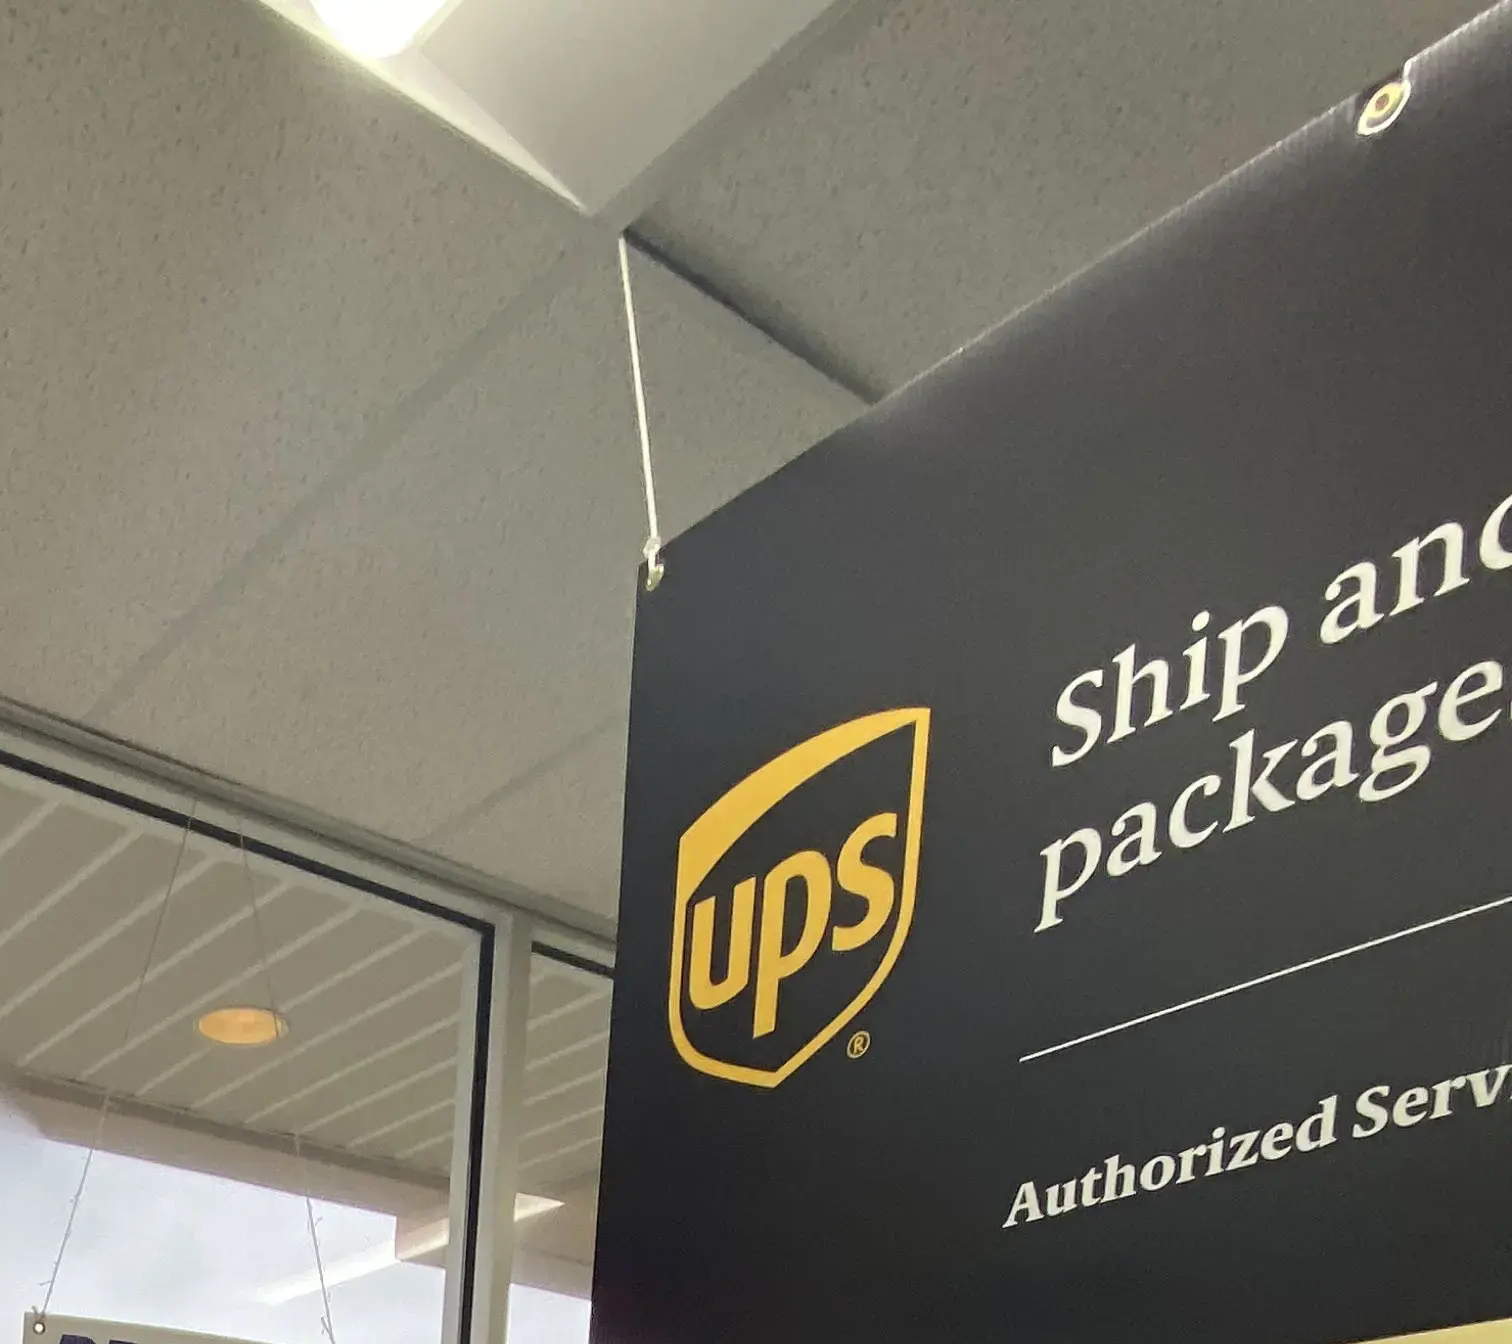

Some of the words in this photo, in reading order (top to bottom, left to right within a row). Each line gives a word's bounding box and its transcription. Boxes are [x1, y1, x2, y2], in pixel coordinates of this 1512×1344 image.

[1050, 603, 1292, 769] Ship
[1033, 659, 1512, 933] package
[688, 811, 898, 1040] ups
[1002, 1095, 1338, 1229] Authorized
[1351, 1063, 1512, 1139] Serv
